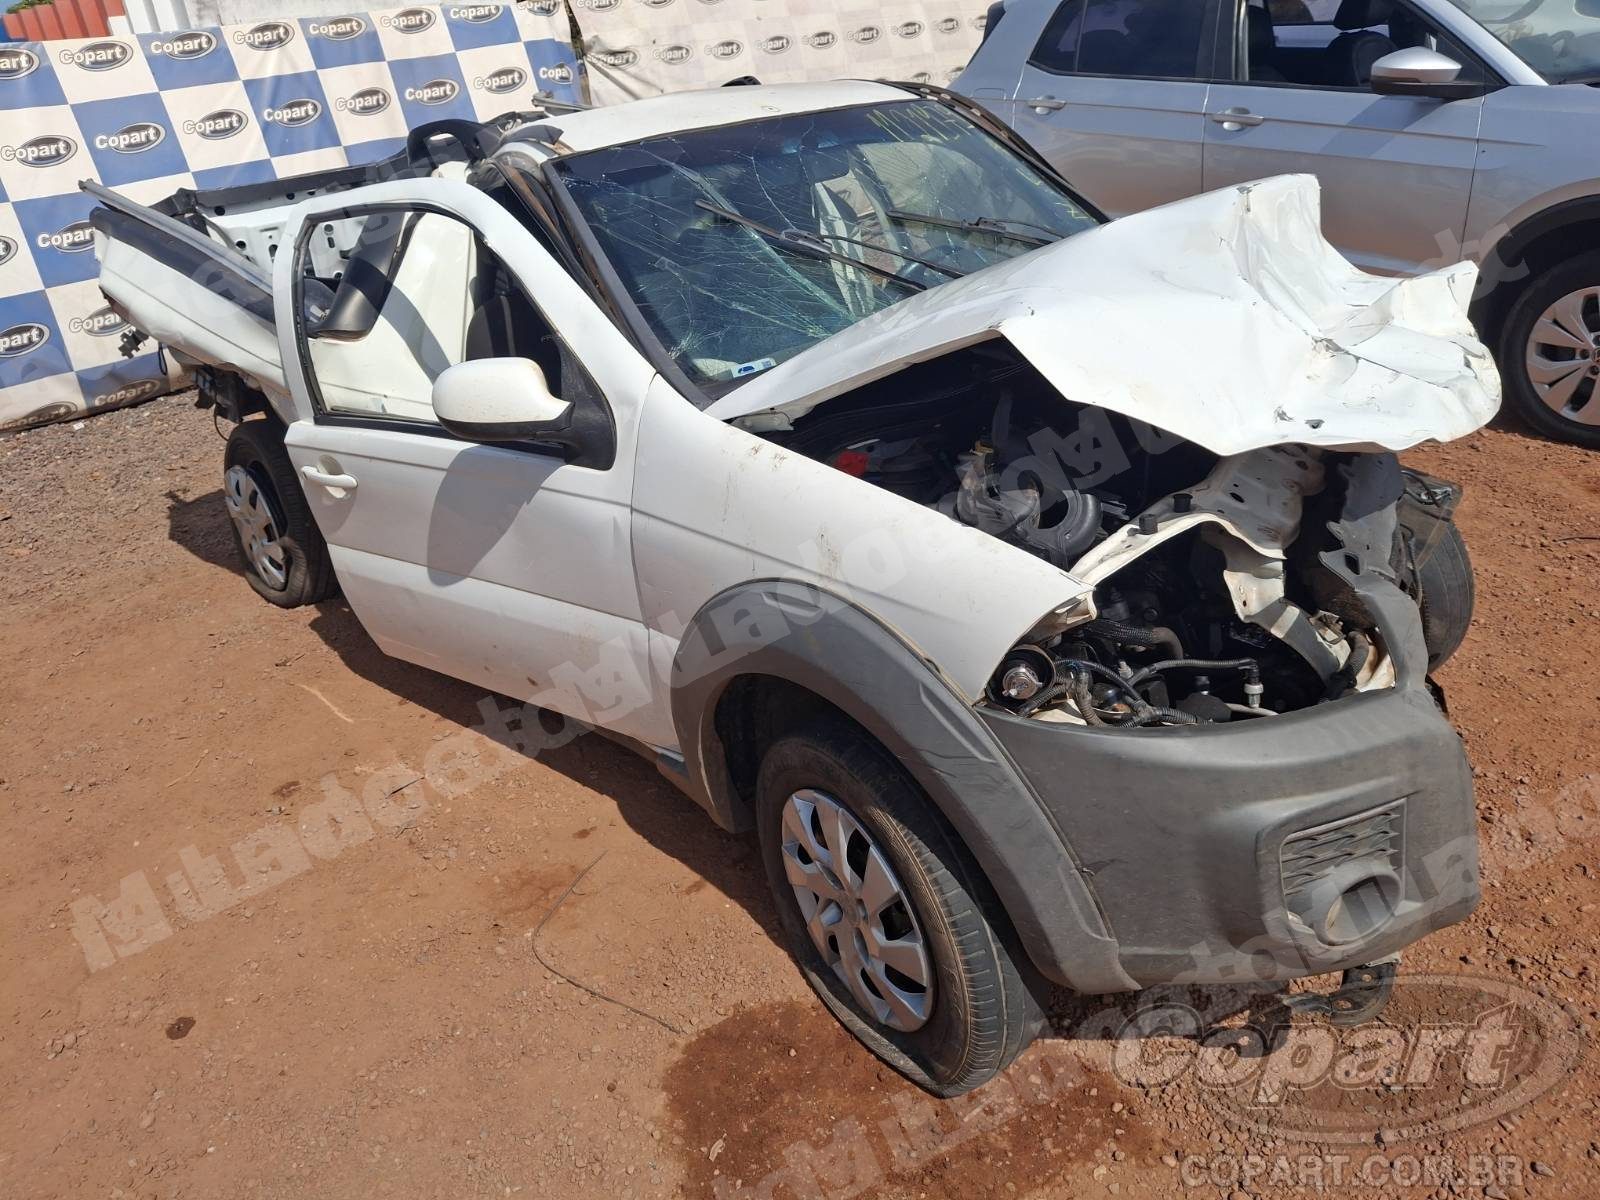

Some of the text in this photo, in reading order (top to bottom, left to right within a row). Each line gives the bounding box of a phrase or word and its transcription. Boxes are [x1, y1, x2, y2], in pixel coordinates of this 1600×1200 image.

[381, 12, 427, 27] Copart
[450, 5, 495, 20] Copart
[234, 25, 287, 45] Copart
[309, 19, 358, 36] Copart
[59, 45, 122, 65] Copart
[150, 35, 209, 55] Copart
[474, 73, 520, 90] Copart
[336, 91, 385, 110] Copart
[405, 84, 452, 101] Copart
[264, 103, 315, 121] Copart
[183, 115, 240, 135] Copart
[95, 127, 155, 149] Copart
[1, 141, 66, 161] Copart
[37, 227, 96, 248] Copar
[94, 384, 154, 407] Copart
